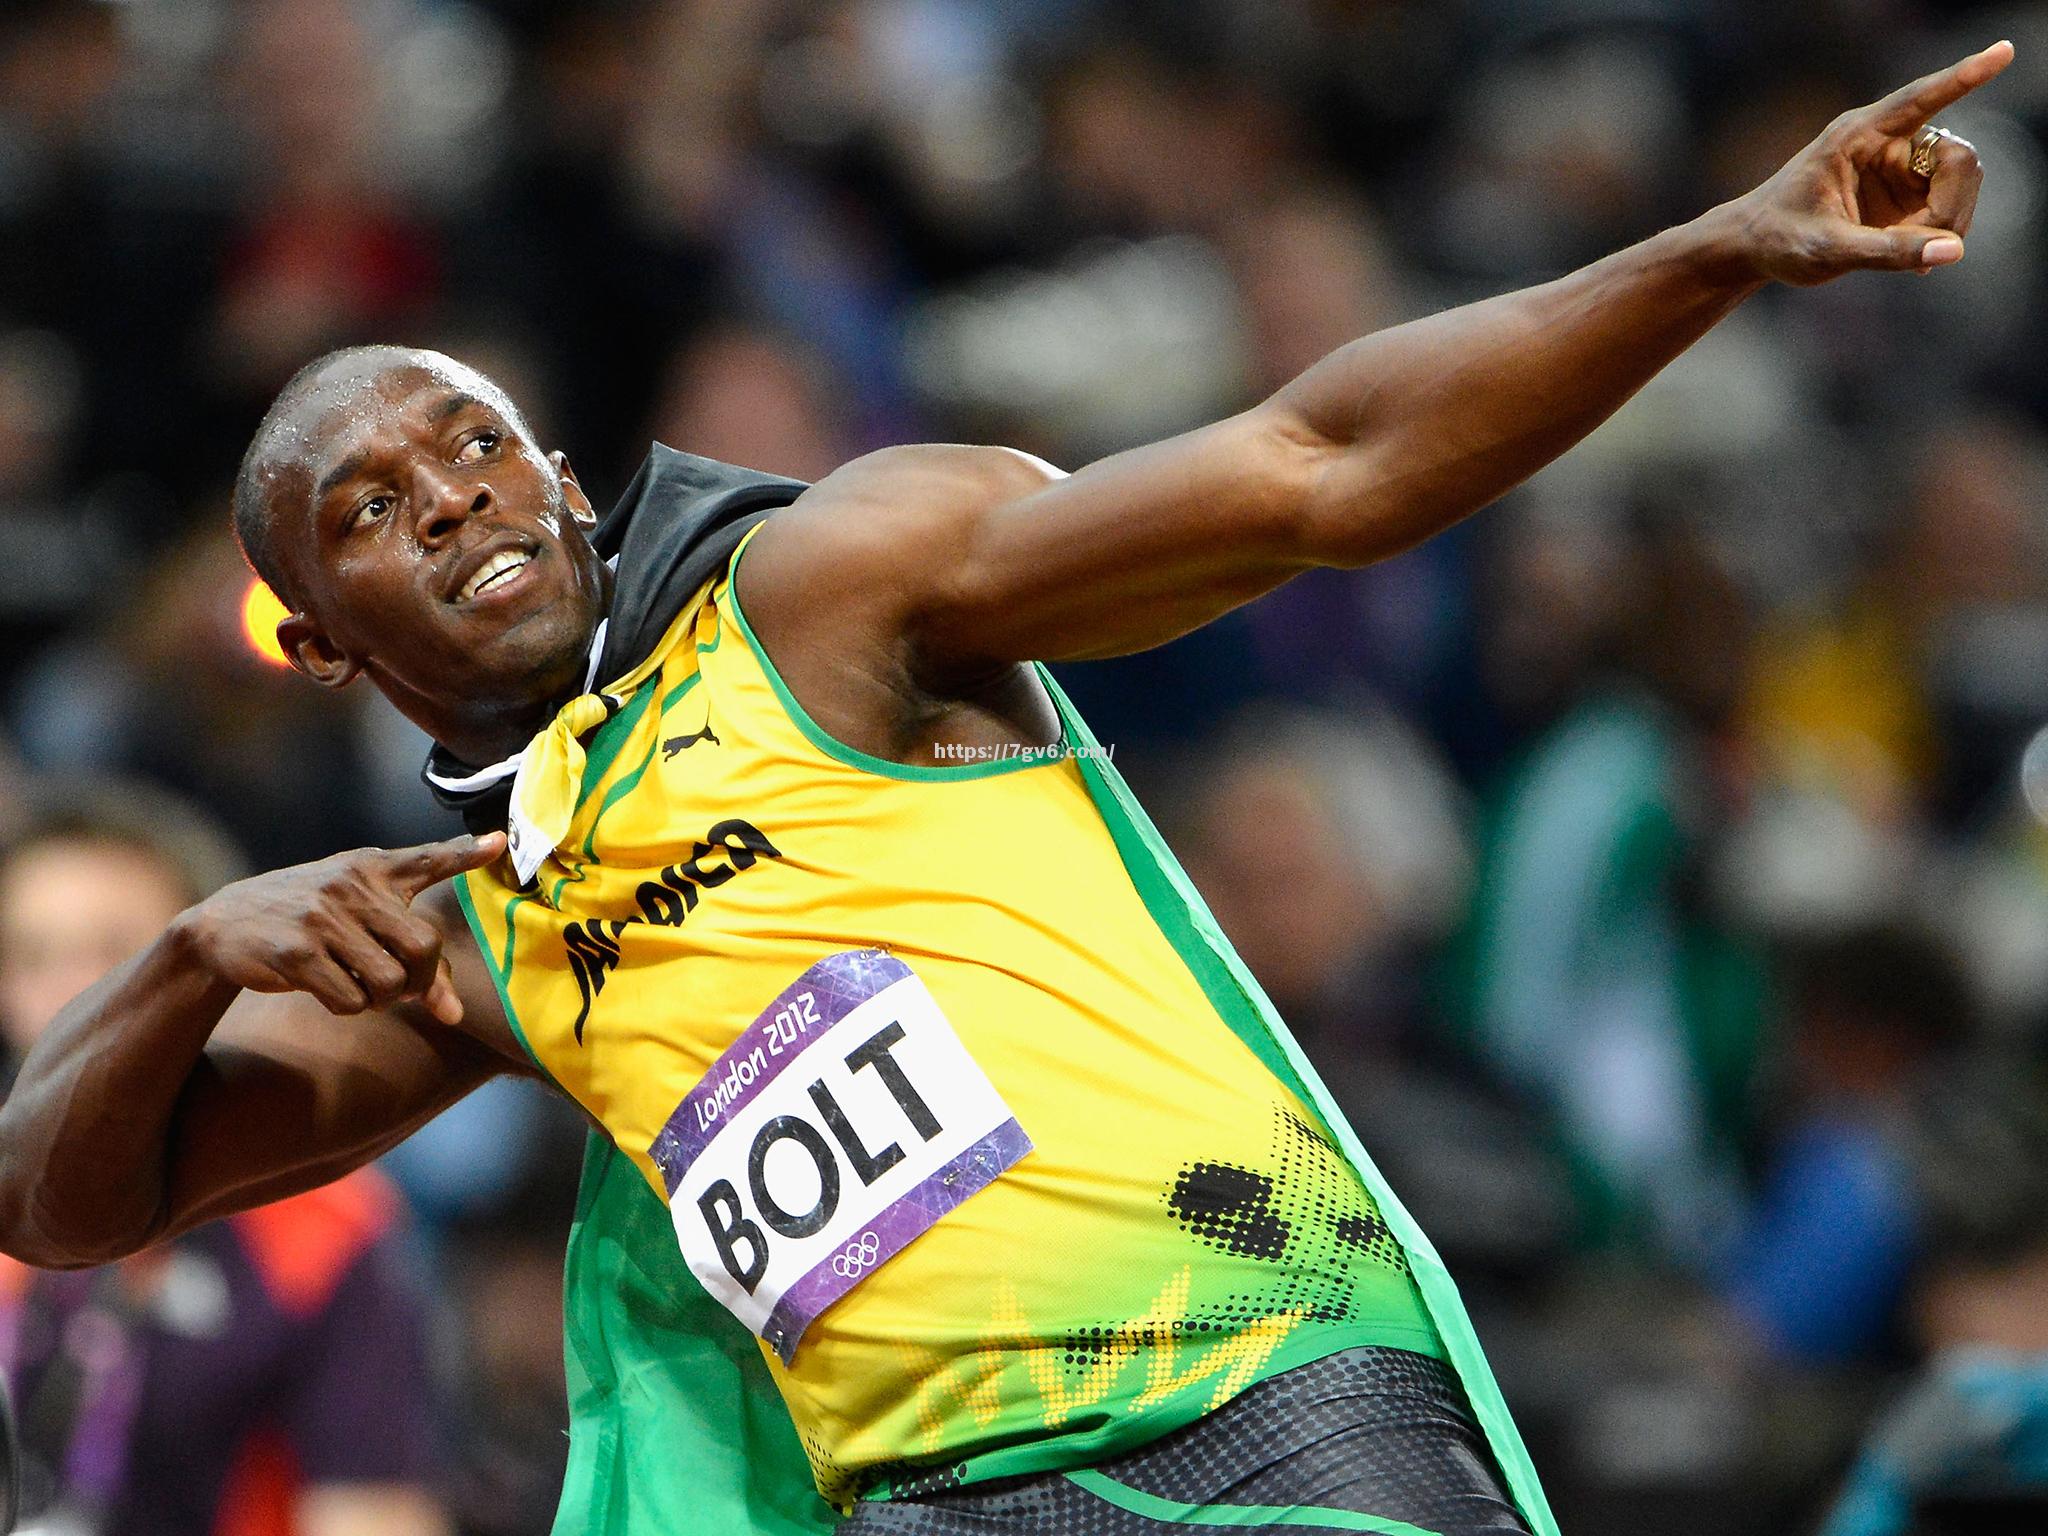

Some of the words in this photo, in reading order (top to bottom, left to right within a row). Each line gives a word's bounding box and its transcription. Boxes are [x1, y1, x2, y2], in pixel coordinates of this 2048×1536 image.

[694, 1046, 768, 1132] London
[762, 991, 821, 1057] 2012
[697, 1020, 943, 1297] BOLT
